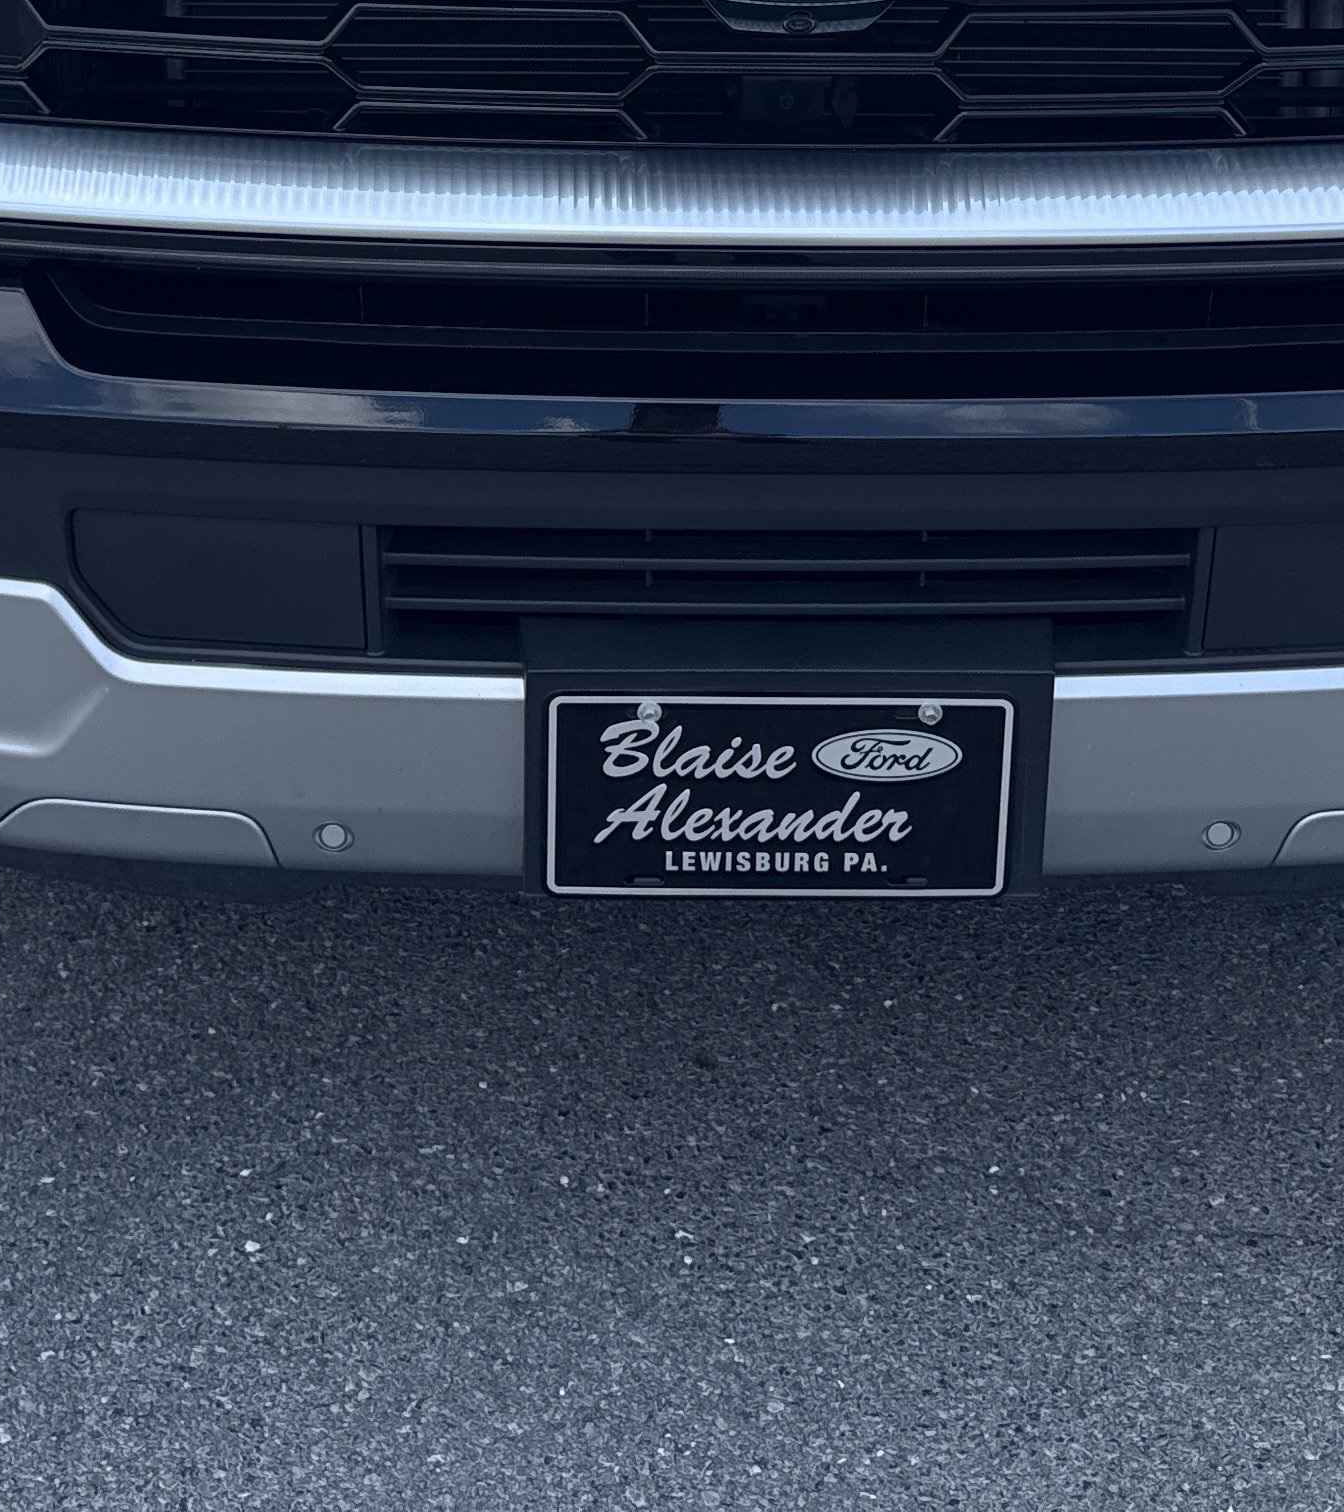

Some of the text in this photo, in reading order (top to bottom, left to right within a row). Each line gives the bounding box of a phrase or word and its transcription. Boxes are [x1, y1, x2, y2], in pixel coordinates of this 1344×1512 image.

[599, 718, 798, 779] Blaise
[840, 737, 932, 773] Ford
[593, 783, 913, 844] Alexander
[665, 851, 888, 873] LEWISBURG PA.
